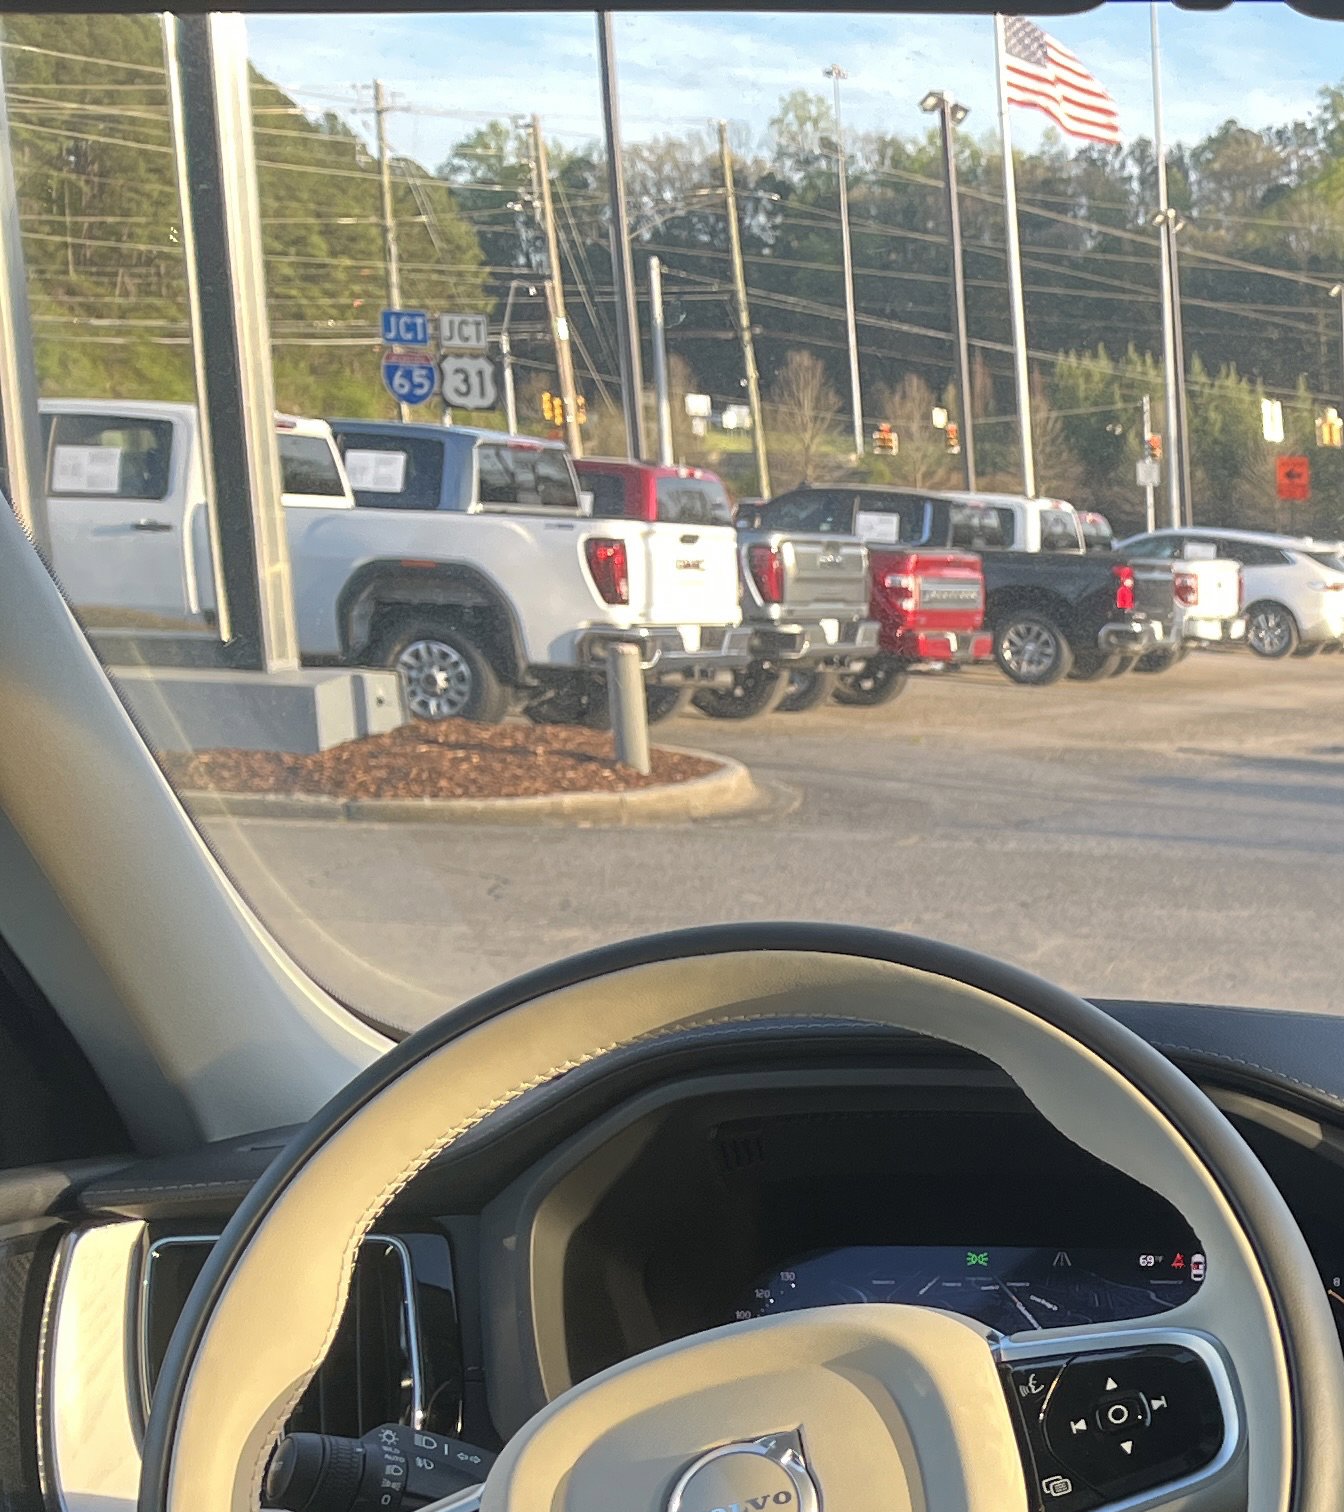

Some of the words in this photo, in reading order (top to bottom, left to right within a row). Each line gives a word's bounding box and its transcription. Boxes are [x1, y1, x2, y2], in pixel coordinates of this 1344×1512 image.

[385, 315, 425, 341] JCT
[443, 319, 482, 343] JCT
[392, 367, 431, 396] 65
[453, 367, 487, 399] 31
